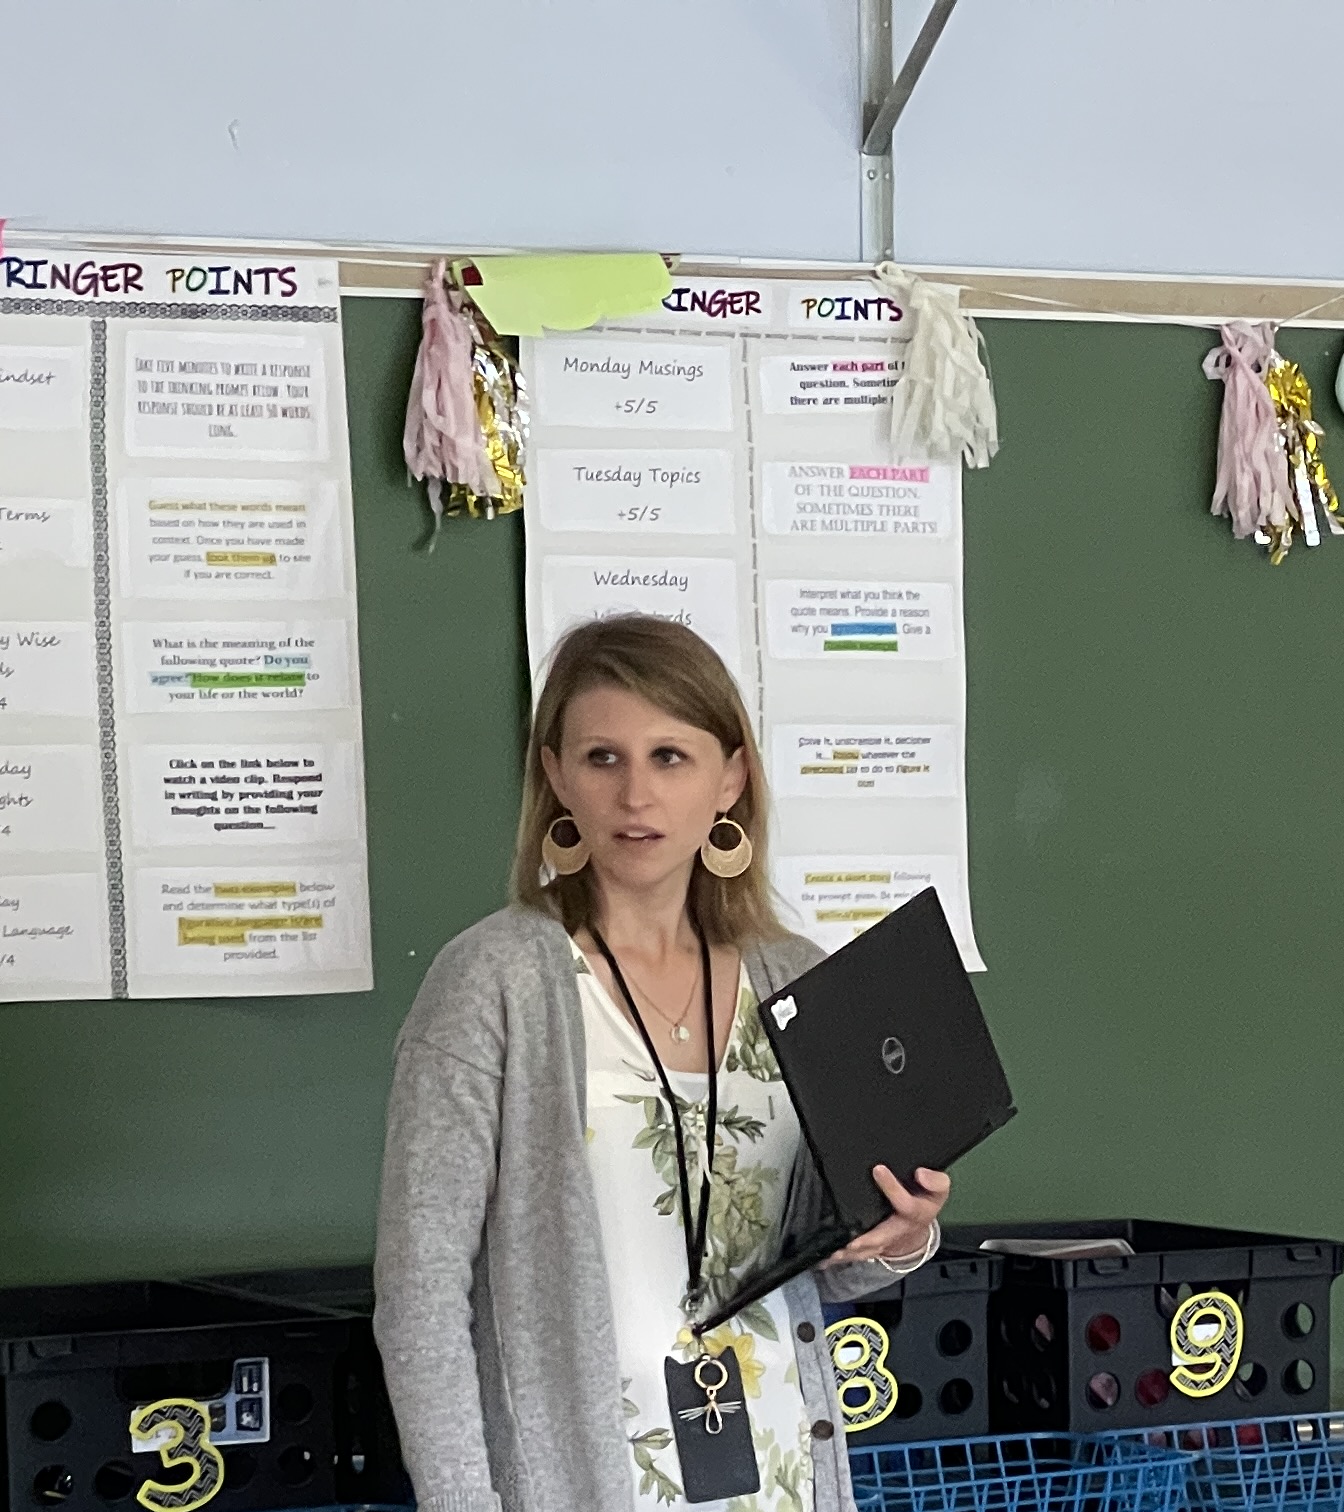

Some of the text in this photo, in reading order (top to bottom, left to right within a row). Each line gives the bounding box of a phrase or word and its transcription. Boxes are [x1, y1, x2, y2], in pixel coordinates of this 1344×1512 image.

[166, 265, 297, 297] POINTS
[802, 296, 902, 321] POINTS
[564, 357, 703, 381] Monday Musings
[790, 361, 898, 372] Answer each part of
[790, 395, 887, 405] there are multiple
[574, 466, 701, 488] Tuesday Topics
[788, 466, 927, 481] ANSWER EACH PART
[795, 484, 919, 499] OF THE QUESTION.
[617, 507, 661, 521] +5/5
[796, 503, 919, 517] SOMETIMES THERE
[791, 520, 887, 532] ARE MULTIPLE
[594, 571, 688, 592] Wednesday
[800, 590, 920, 601] Interpret what you think the
[153, 638, 314, 650] What is the meaning of the
[169, 759, 197, 768] Click
[219, 760, 236, 768] the
[241, 759, 261, 768] link
[267, 759, 298, 767] below
[303, 759, 314, 767] to
[2, 925, 74, 940] Language
[1169, 1290, 1244, 1397] 9
[825, 1316, 898, 1434] 8
